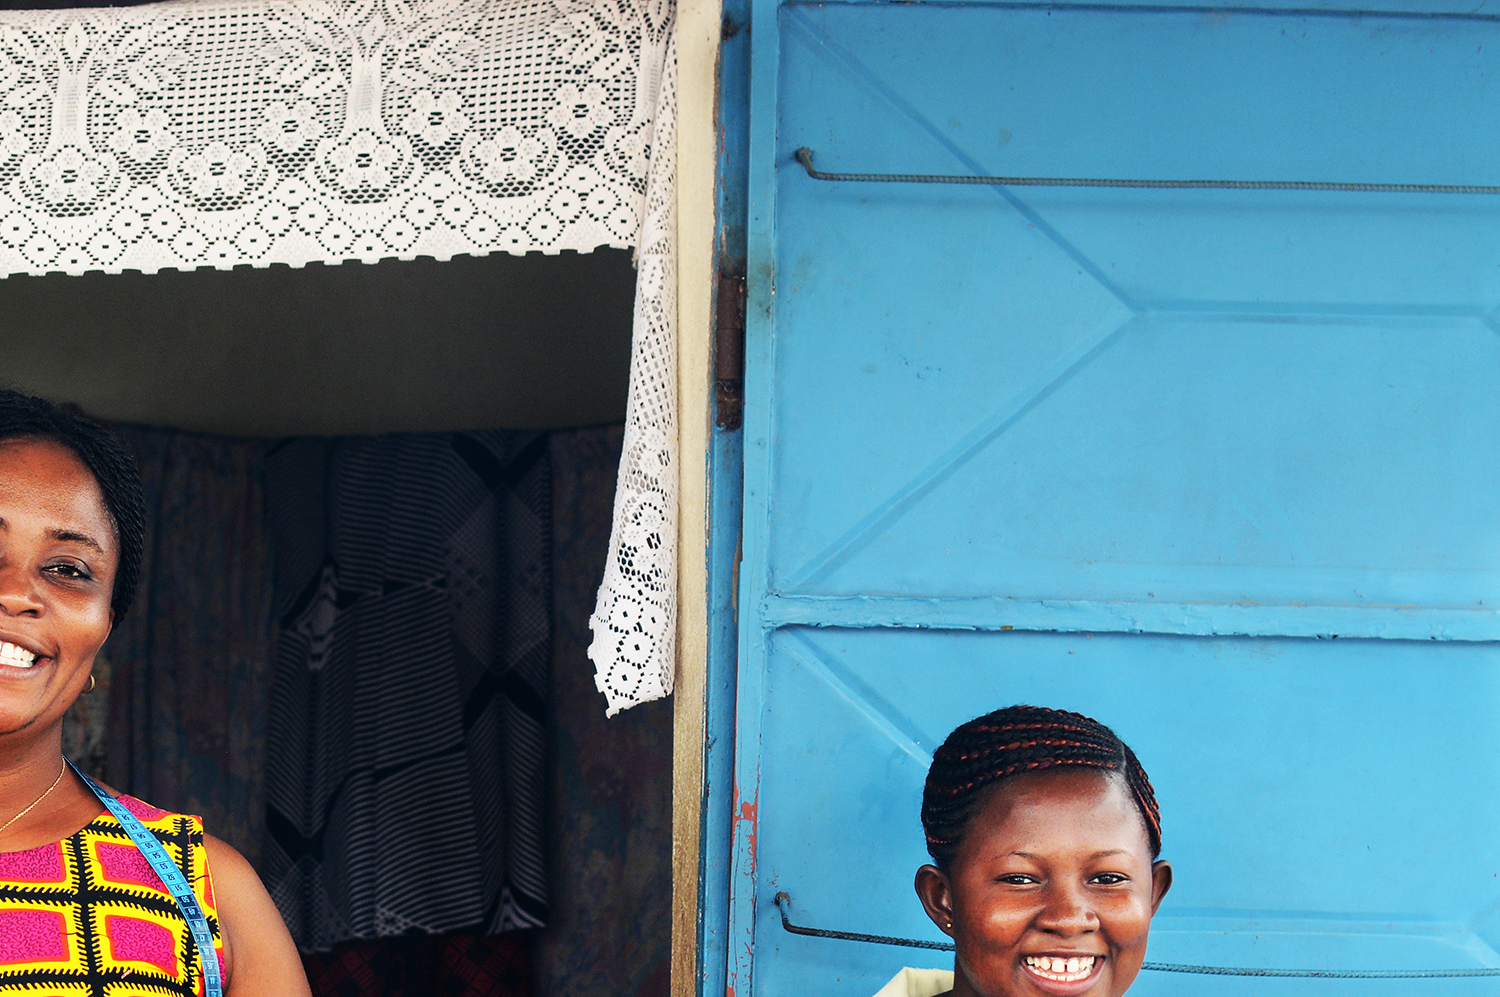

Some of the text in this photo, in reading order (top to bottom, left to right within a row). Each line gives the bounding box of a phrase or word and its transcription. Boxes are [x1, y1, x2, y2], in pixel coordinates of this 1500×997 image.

[152, 851, 161, 859] 54
[167, 873, 176, 881] 52
[174, 884, 183, 892] 51
